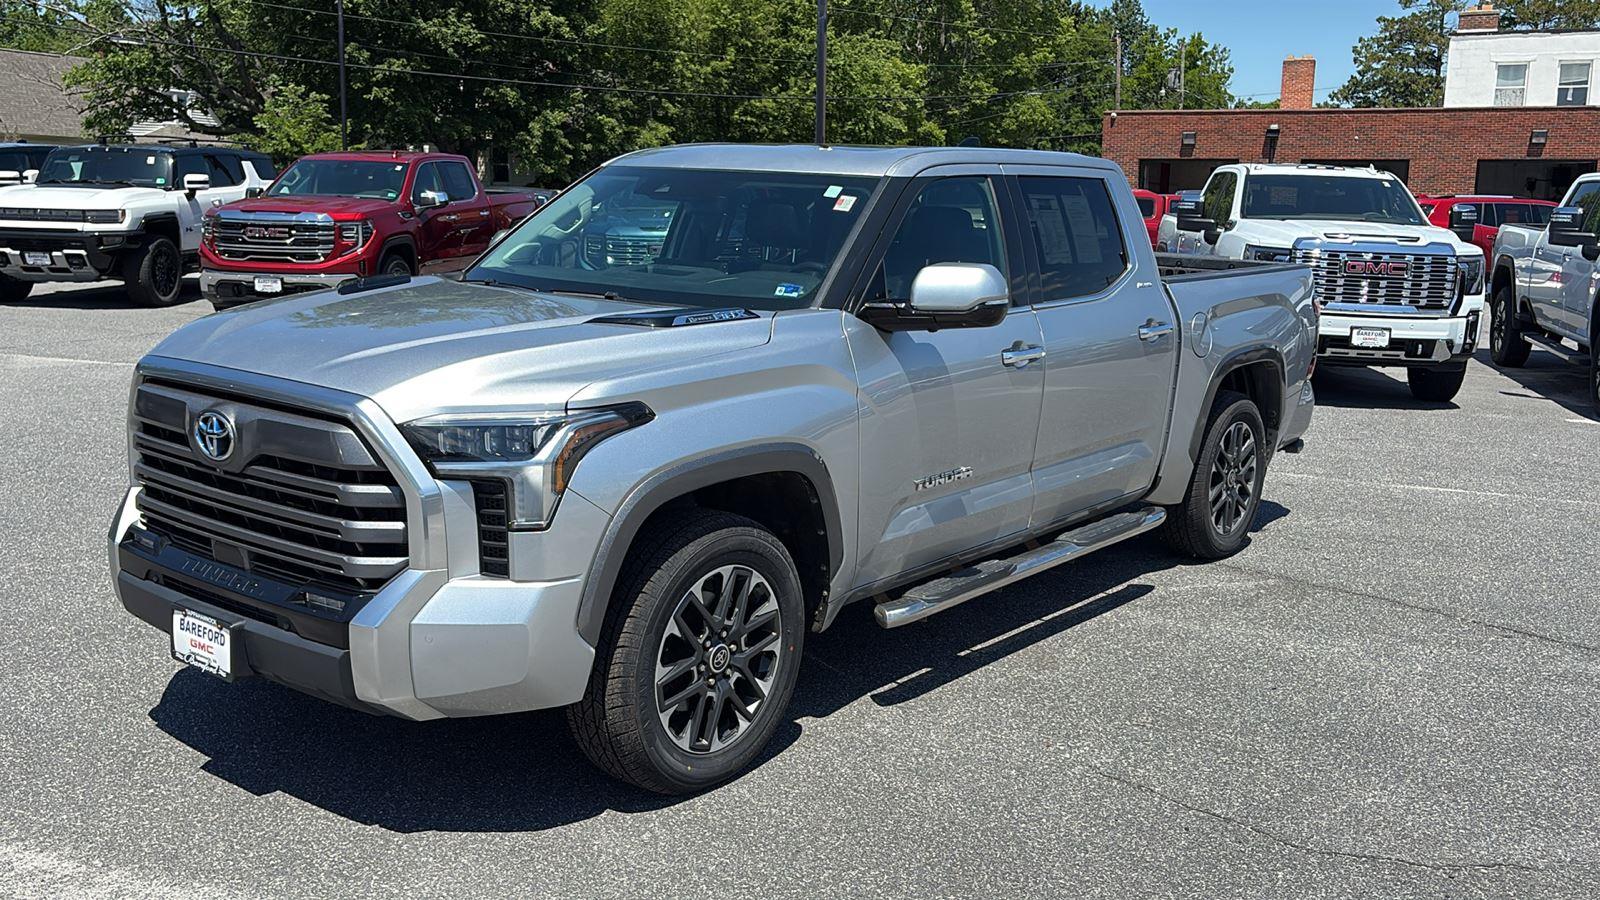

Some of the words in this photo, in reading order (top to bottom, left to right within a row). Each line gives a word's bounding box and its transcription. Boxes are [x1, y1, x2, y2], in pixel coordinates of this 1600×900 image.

[245, 227, 289, 237] GMC
[1346, 261, 1407, 276] GMC
[913, 466, 973, 491] TUNDRA
[180, 618, 225, 646] BAREFORD
[190, 639, 214, 655] GMC
